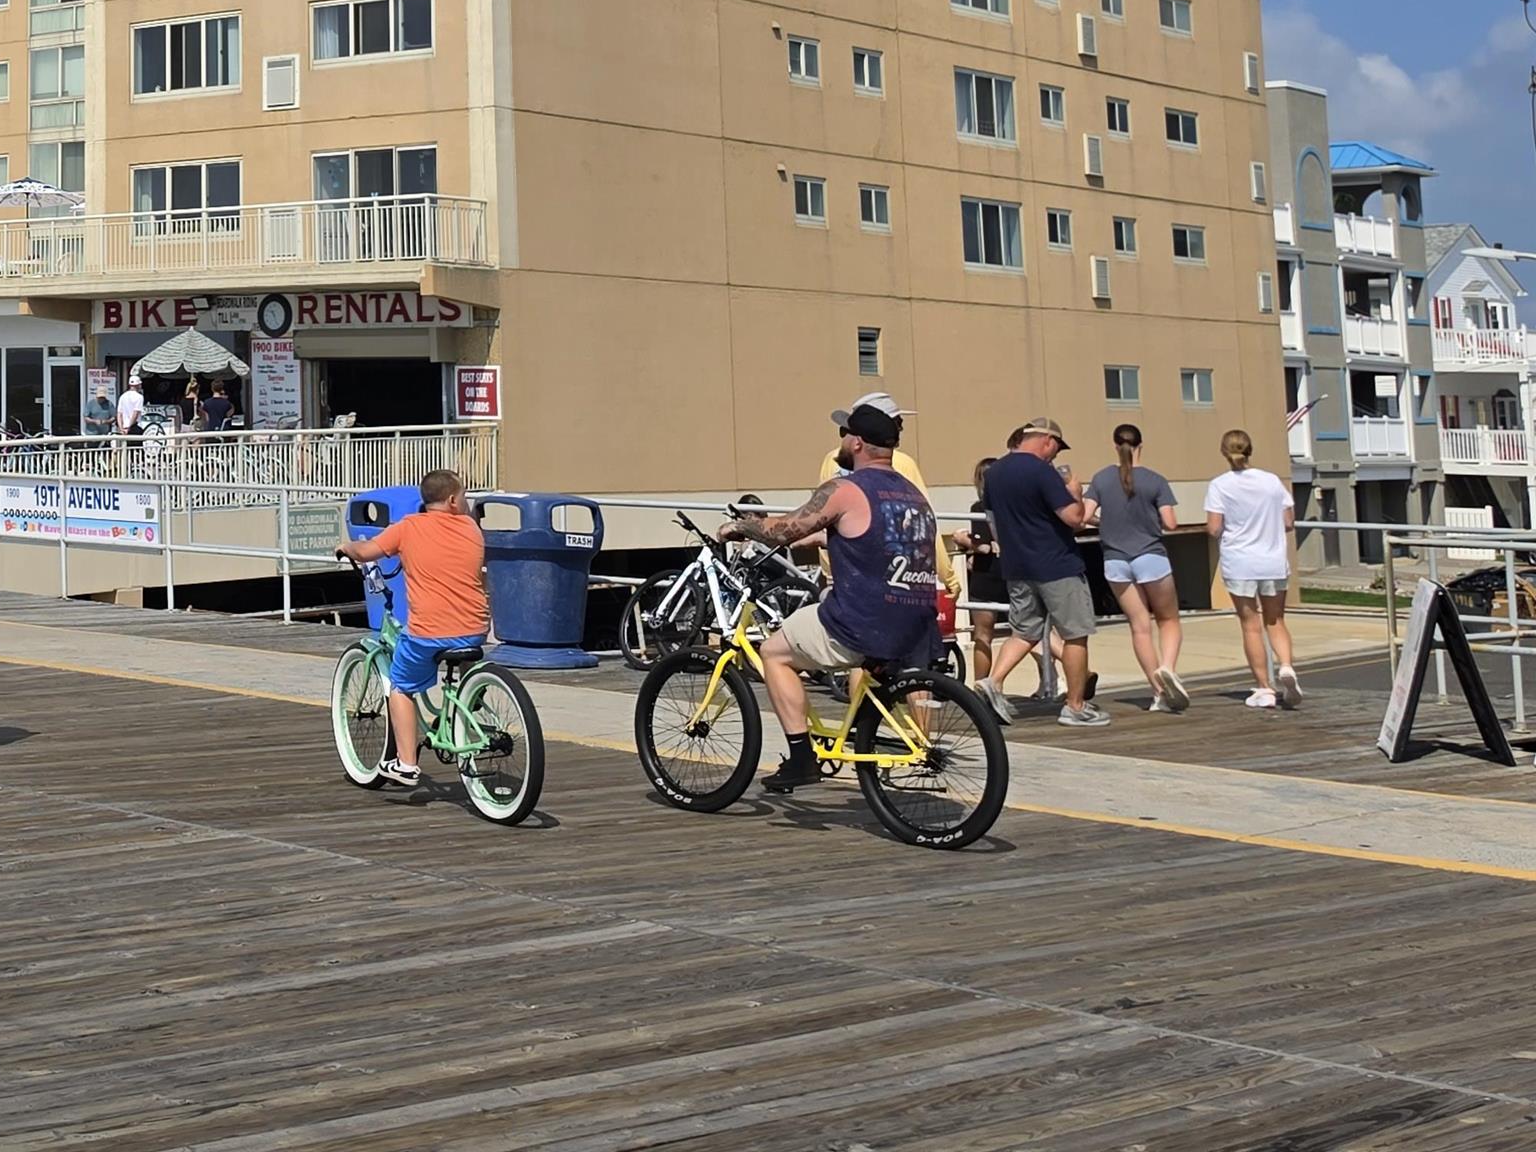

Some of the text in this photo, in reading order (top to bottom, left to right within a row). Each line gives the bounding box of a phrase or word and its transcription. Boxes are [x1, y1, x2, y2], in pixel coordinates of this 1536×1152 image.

[103, 292, 462, 329] BIKE RENTALS
[253, 341, 294, 352] 1900 BIKE
[461, 372, 475, 383] BEST
[68, 487, 120, 511] AVENUE
[296, 512, 339, 525] BOARDWALK
[289, 523, 334, 536] ONDOMINIUM
[289, 535, 341, 550] VATE PARKING
[567, 535, 592, 546] TRASH
